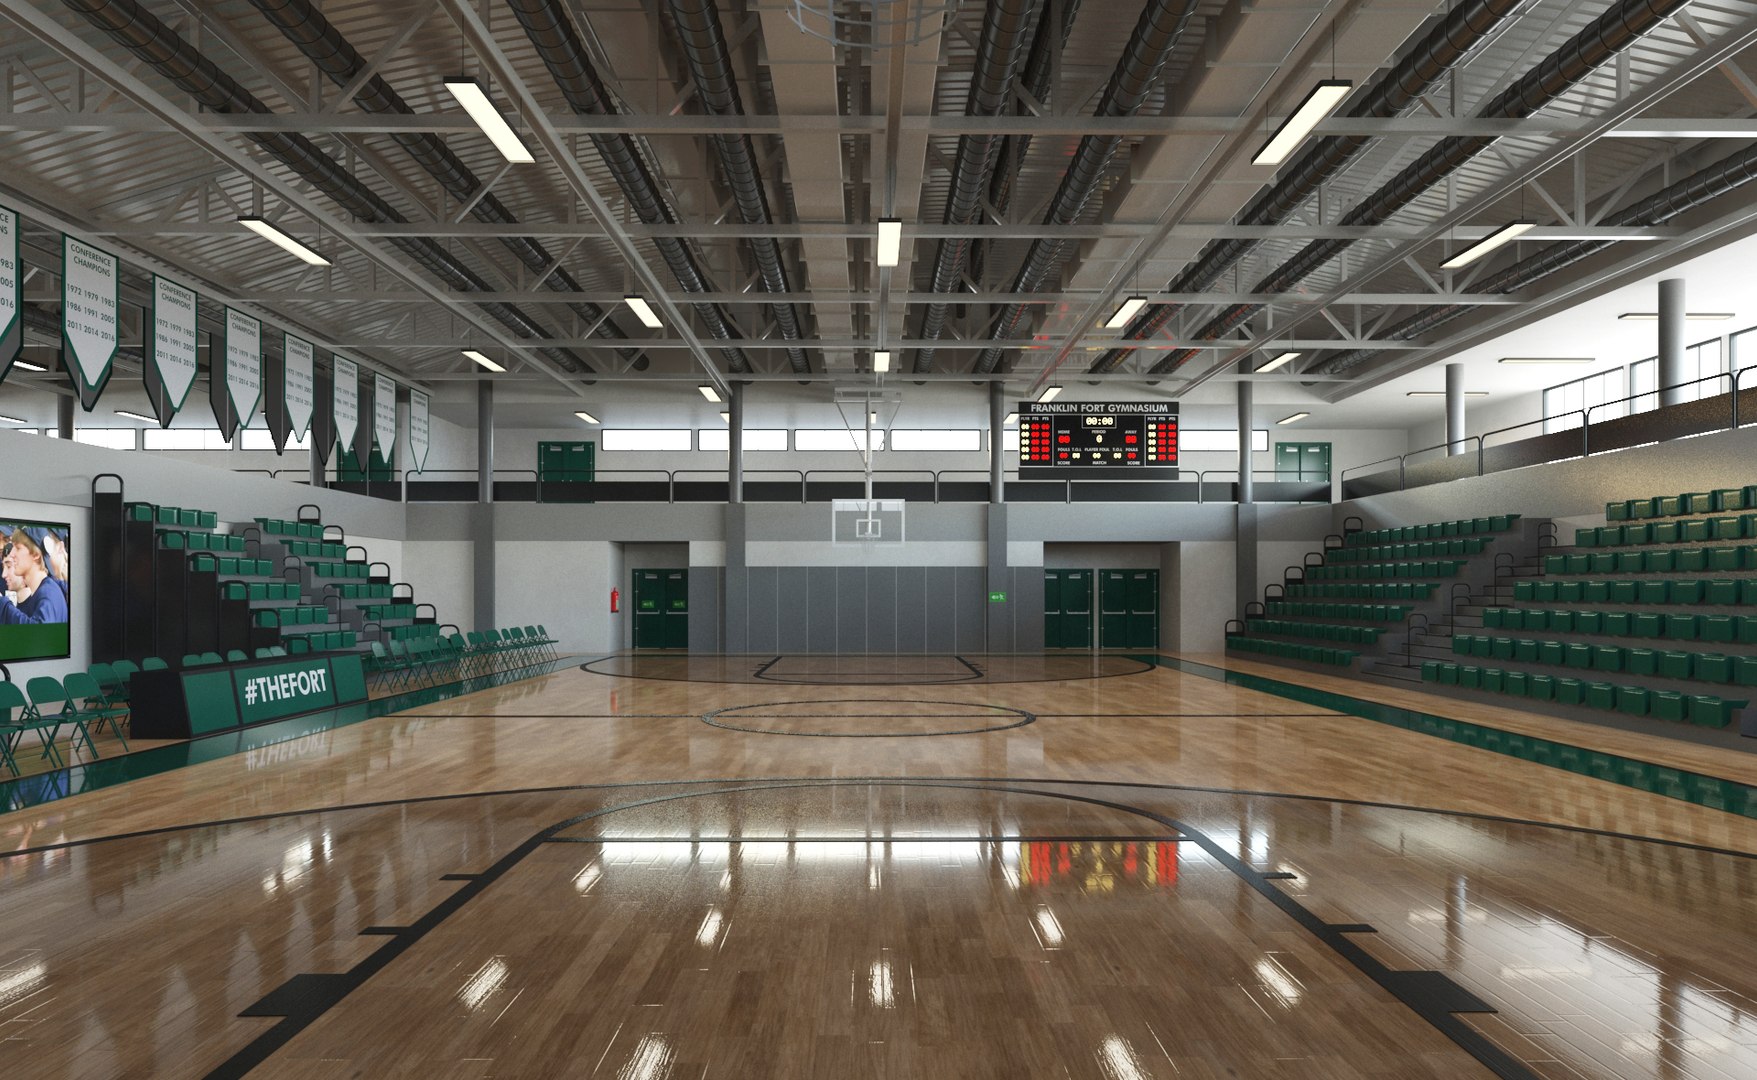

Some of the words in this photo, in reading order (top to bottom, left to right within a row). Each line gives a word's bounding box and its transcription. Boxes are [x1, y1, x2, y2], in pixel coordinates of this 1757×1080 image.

[71, 244, 111, 267] CONFERENCE
[74, 256, 110, 277] CHAMPIONS
[67, 284, 82, 296] 1972
[84, 290, 98, 302] 1979
[101, 296, 114, 308] 1983
[160, 282, 191, 302] CONFERENCE
[162, 293, 190, 310] CHAMPIONS
[0, 297, 14, 309] 016
[67, 301, 82, 312] 1986
[84, 306, 98, 318] 1991
[101, 313, 114, 324] 2005
[67, 320, 82, 330] 2011
[84, 326, 98, 336] 2014
[101, 331, 114, 342] 2016
[170, 338, 181, 348] 1991
[156, 350, 168, 360] 2011
[1030, 404, 1078, 412] FRANKLIN
[1081, 404, 1105, 412] FORT
[1108, 404, 1168, 412] GYMNASIUM
[245, 668, 327, 706] #THEFORT
